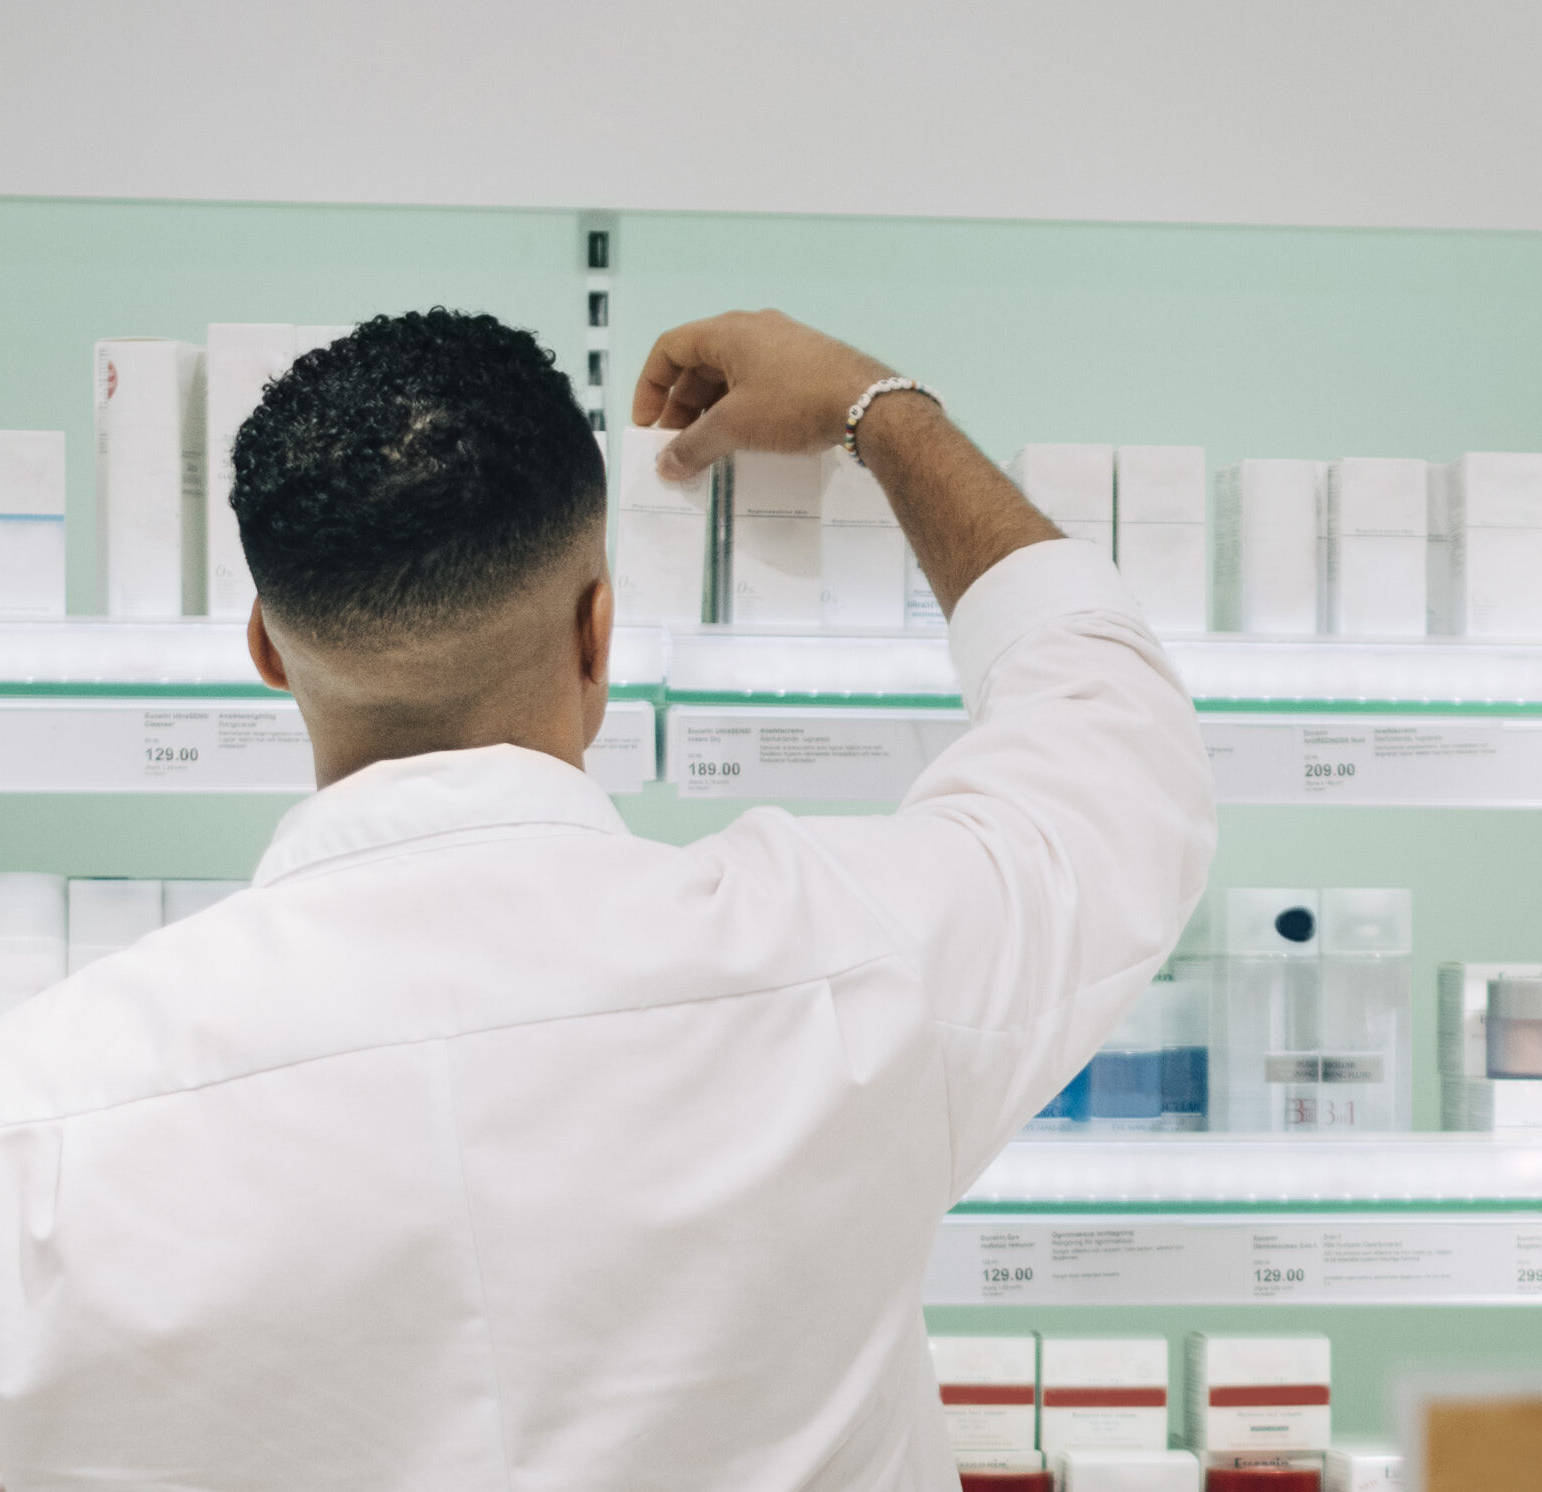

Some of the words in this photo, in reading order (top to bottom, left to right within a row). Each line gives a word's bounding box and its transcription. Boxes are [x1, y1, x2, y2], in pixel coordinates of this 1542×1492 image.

[145, 747, 199, 761] 129.00
[689, 762, 741, 777] 189.00
[1304, 763, 1356, 778] 209.00
[983, 1267, 1034, 1283] 129.00
[1254, 1268, 1305, 1283] 129.00
